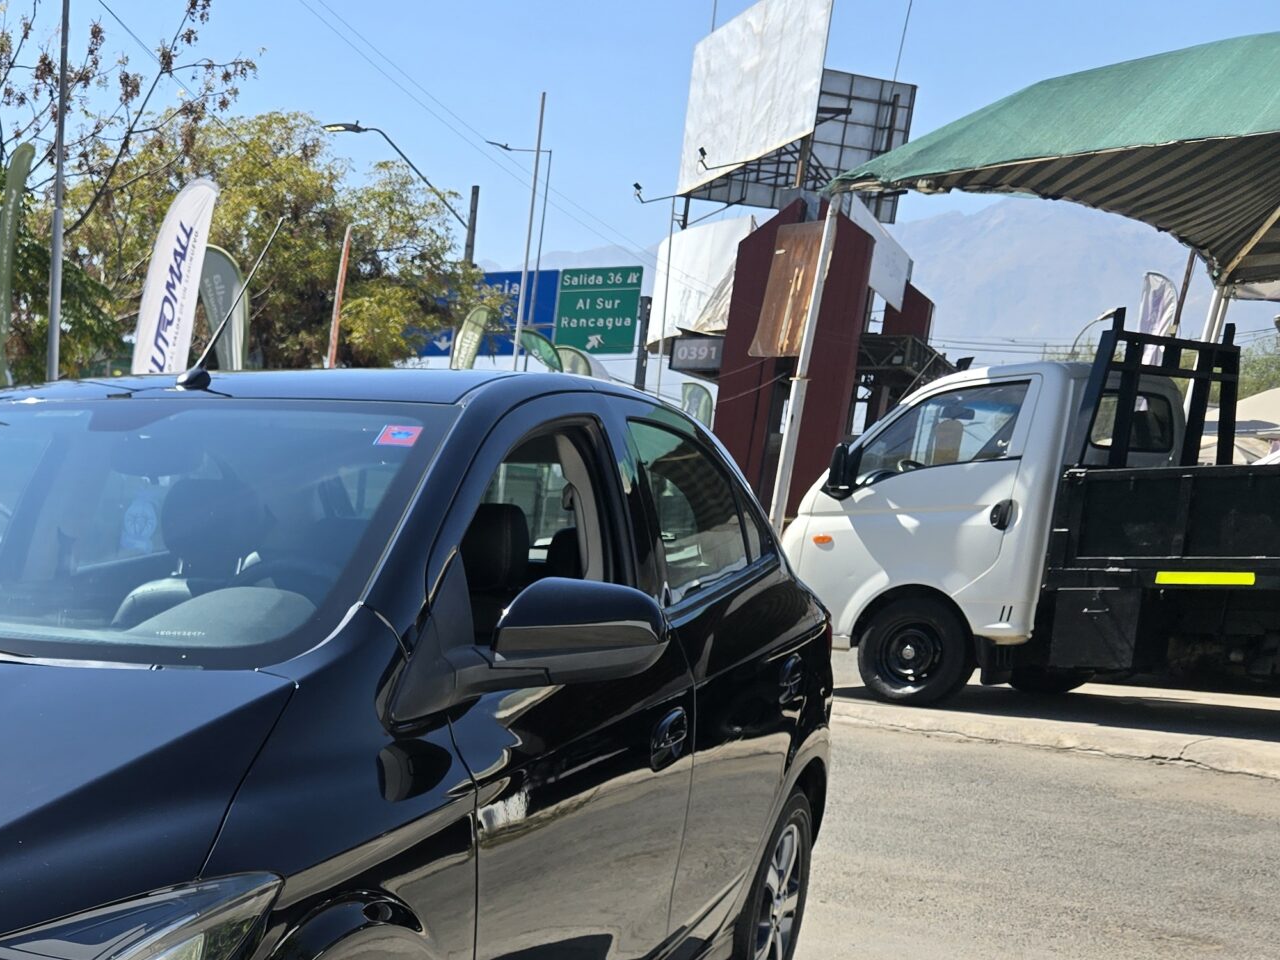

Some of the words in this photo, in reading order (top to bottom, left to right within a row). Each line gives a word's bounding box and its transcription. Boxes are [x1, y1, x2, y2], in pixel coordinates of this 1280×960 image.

[562, 273, 604, 286] Salida
[606, 272, 623, 285] 36
[148, 220, 194, 373] UTOMALL
[576, 298, 591, 310] Al
[595, 297, 621, 310] Sur
[560, 316, 632, 330] Rancagua
[677, 346, 717, 360] 0391
